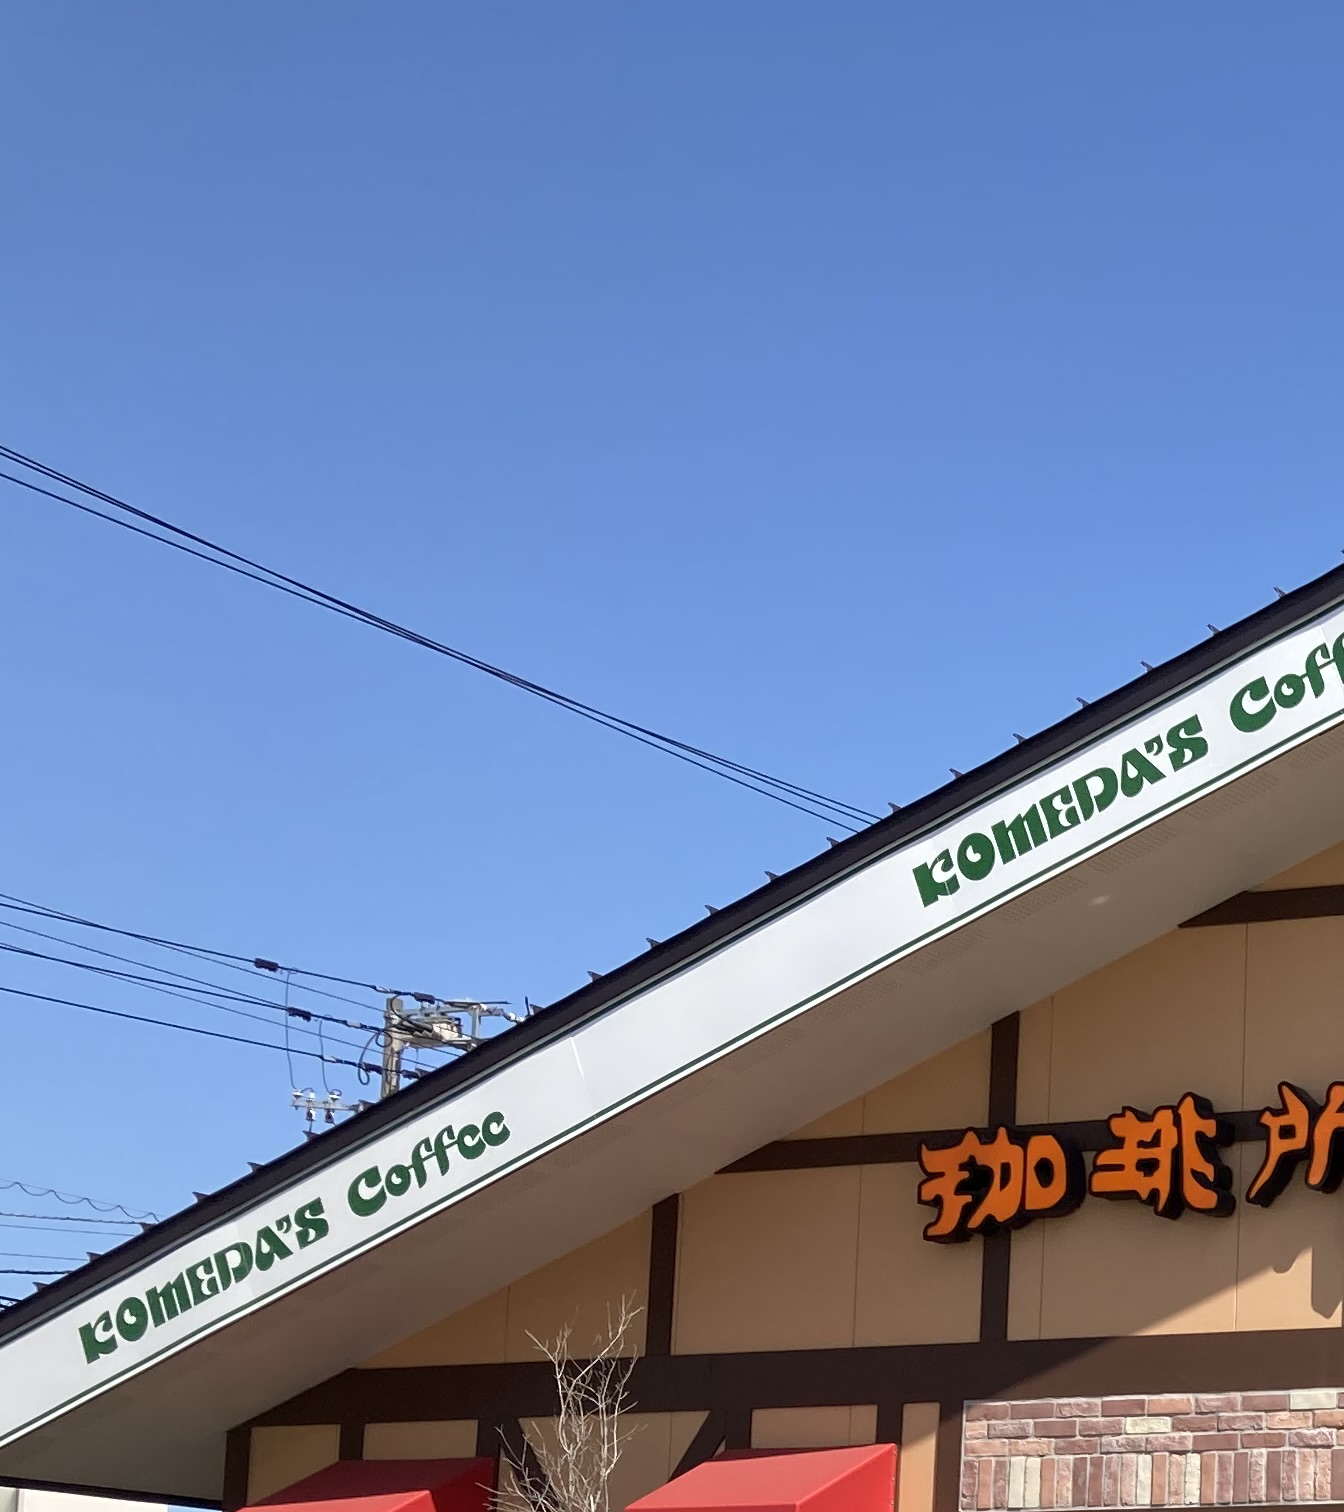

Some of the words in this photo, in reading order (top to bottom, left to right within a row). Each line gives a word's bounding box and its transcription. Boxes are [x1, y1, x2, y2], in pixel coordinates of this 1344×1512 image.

[912, 713, 1209, 908] KOMEDA'S
[77, 1197, 330, 1364] KOMEDA'S
[348, 1110, 511, 1216] Coffee
